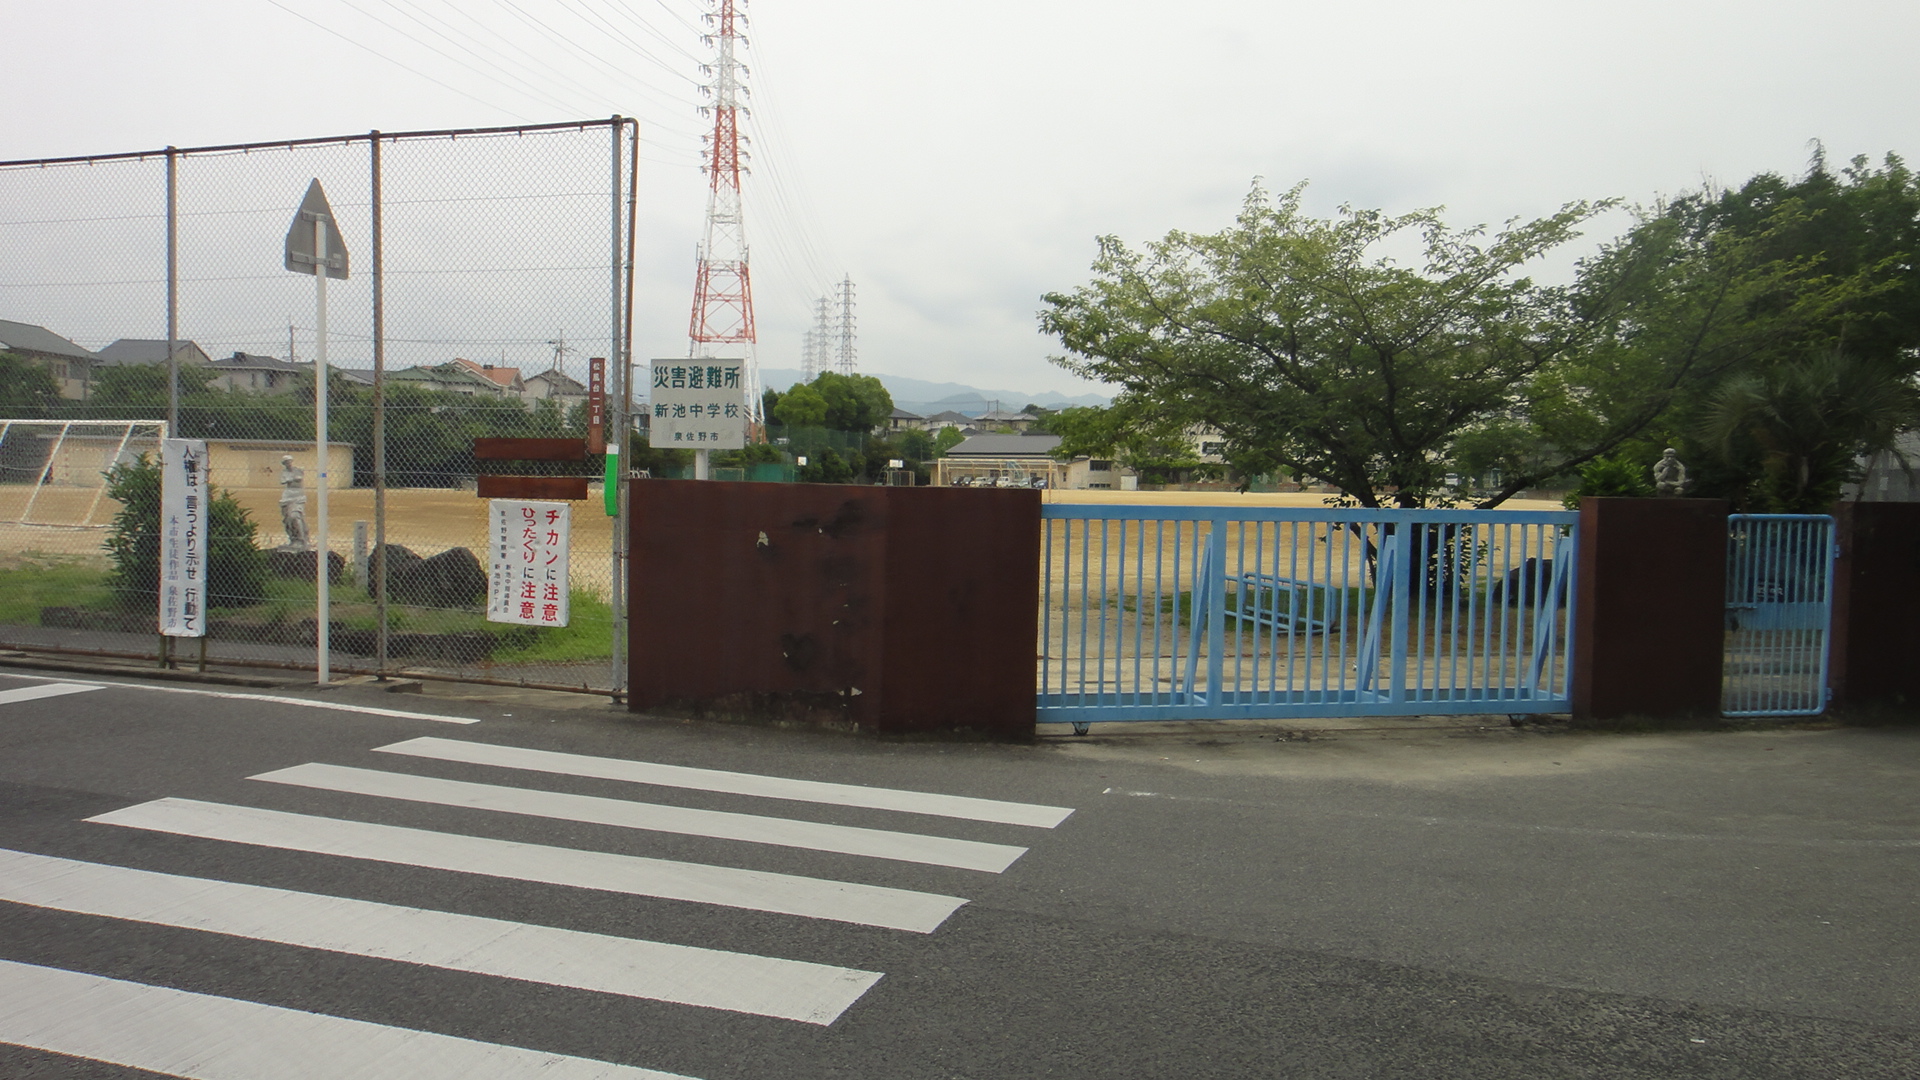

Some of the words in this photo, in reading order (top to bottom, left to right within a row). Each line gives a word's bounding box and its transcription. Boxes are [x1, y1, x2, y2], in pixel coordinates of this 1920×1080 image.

[592, 363, 600, 425] 松風台一丁目
[654, 366, 740, 389] 災害避難所
[654, 403, 739, 418] 新池中学校
[674, 432, 719, 441] 泉佐野市
[519, 507, 537, 619] ひったくりに注意
[541, 510, 559, 621] チカンに注意
[167, 585, 178, 628] 泉佐野市
